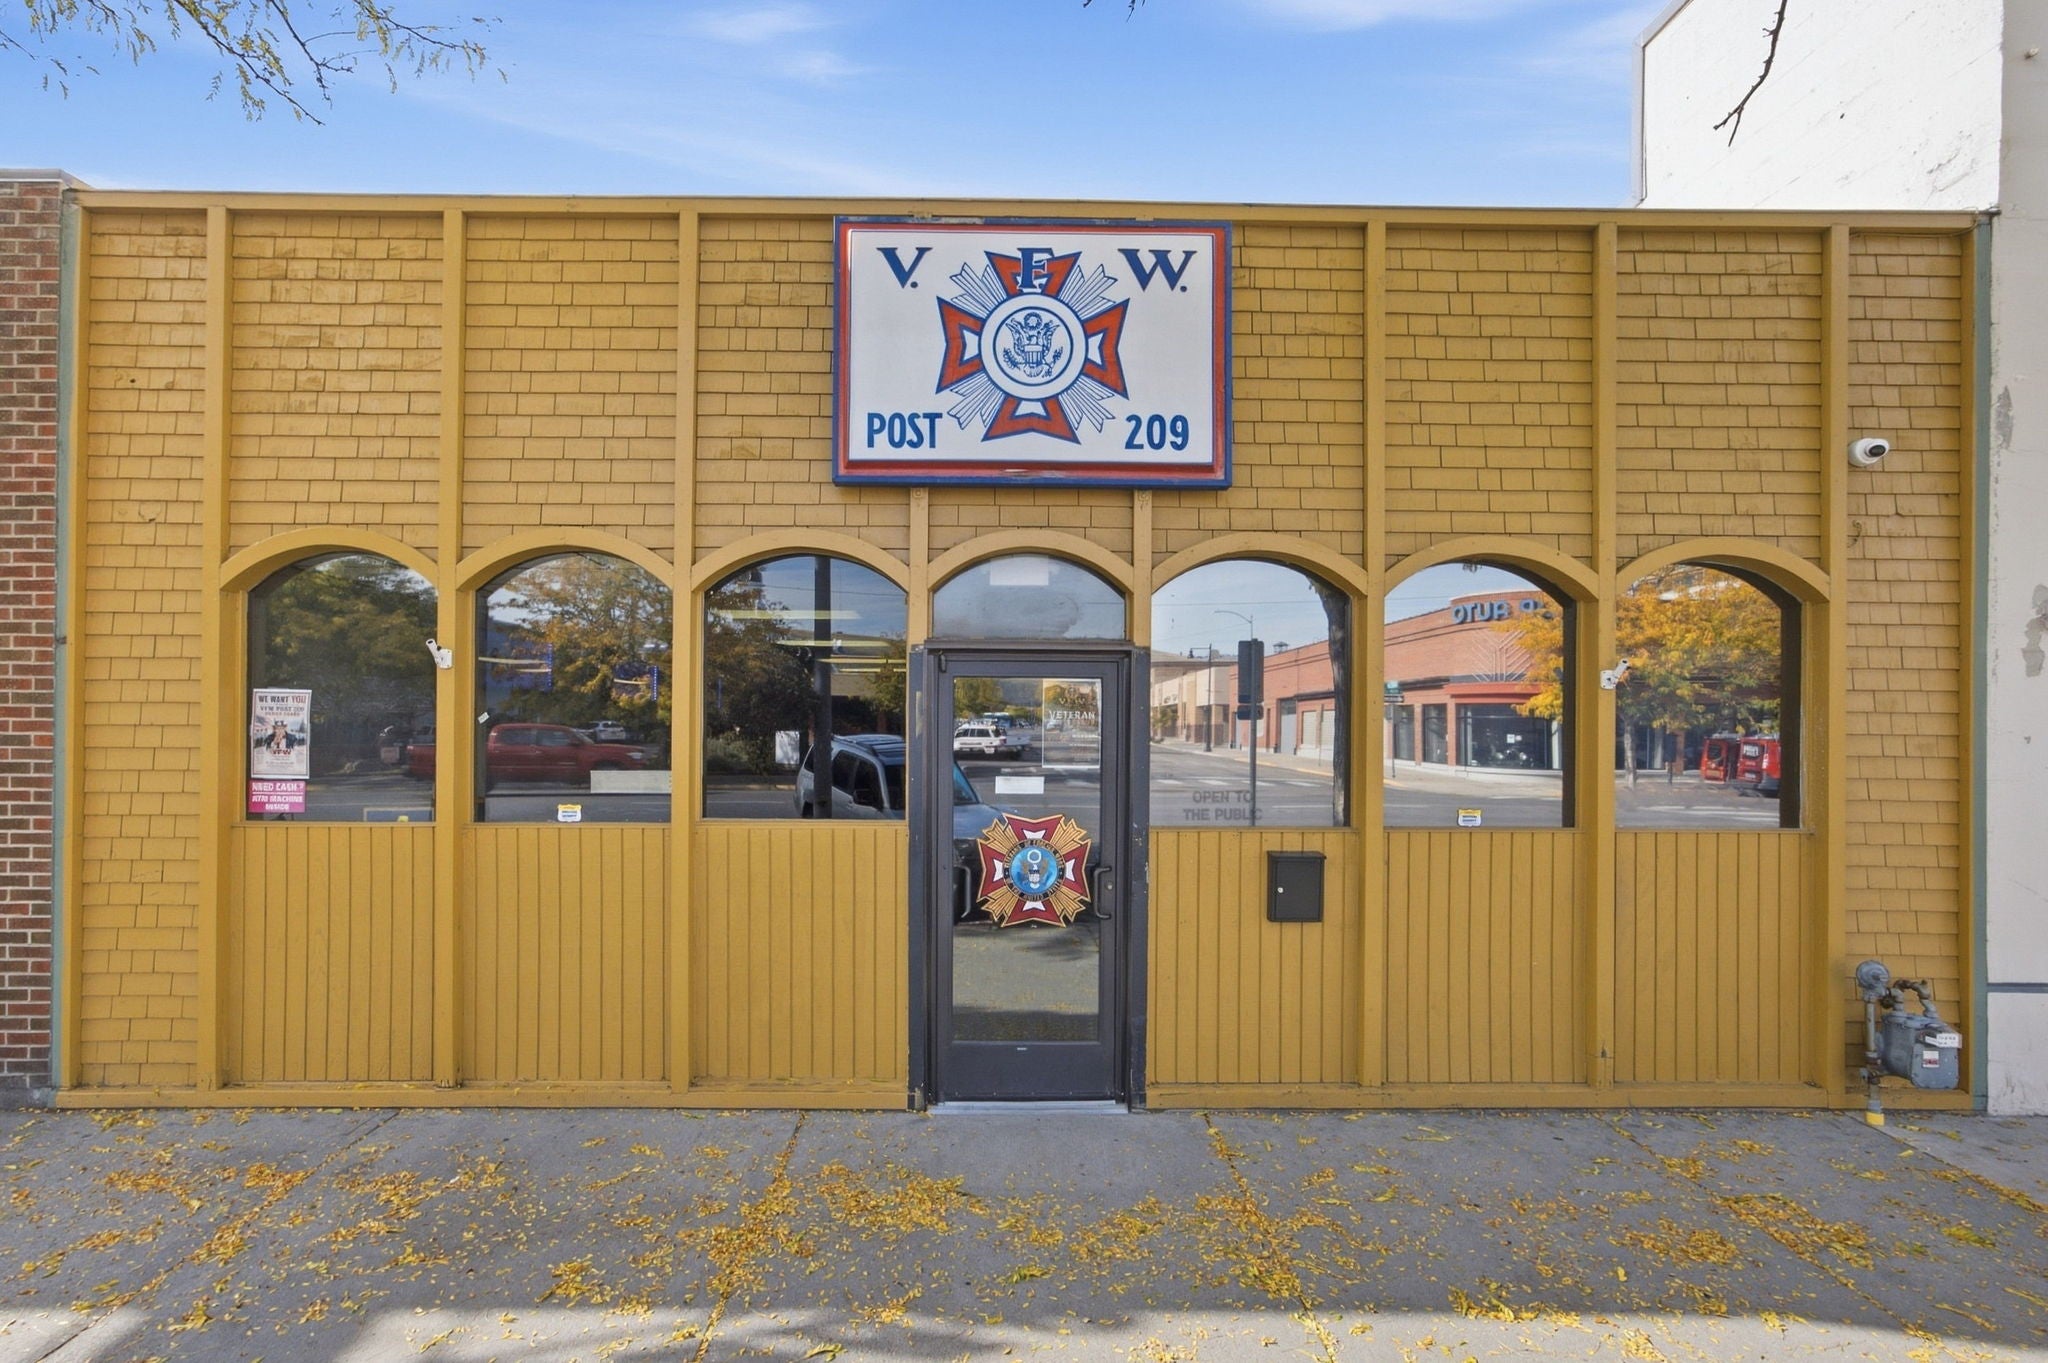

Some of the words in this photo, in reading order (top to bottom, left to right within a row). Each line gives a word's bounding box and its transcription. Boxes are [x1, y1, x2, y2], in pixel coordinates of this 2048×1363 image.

[876, 247, 932, 289] V.
[1117, 248, 1197, 293] W.
[867, 411, 943, 449] POST
[1124, 413, 1190, 451] 209
[258, 695, 268, 703] WE
[270, 695, 289, 703] WANT
[291, 695, 307, 704] YOU
[1049, 710, 1096, 720] VETERAN
[252, 783, 273, 791] NEED
[1192, 790, 1229, 803] OPEN
[1184, 809, 1210, 821] THE
